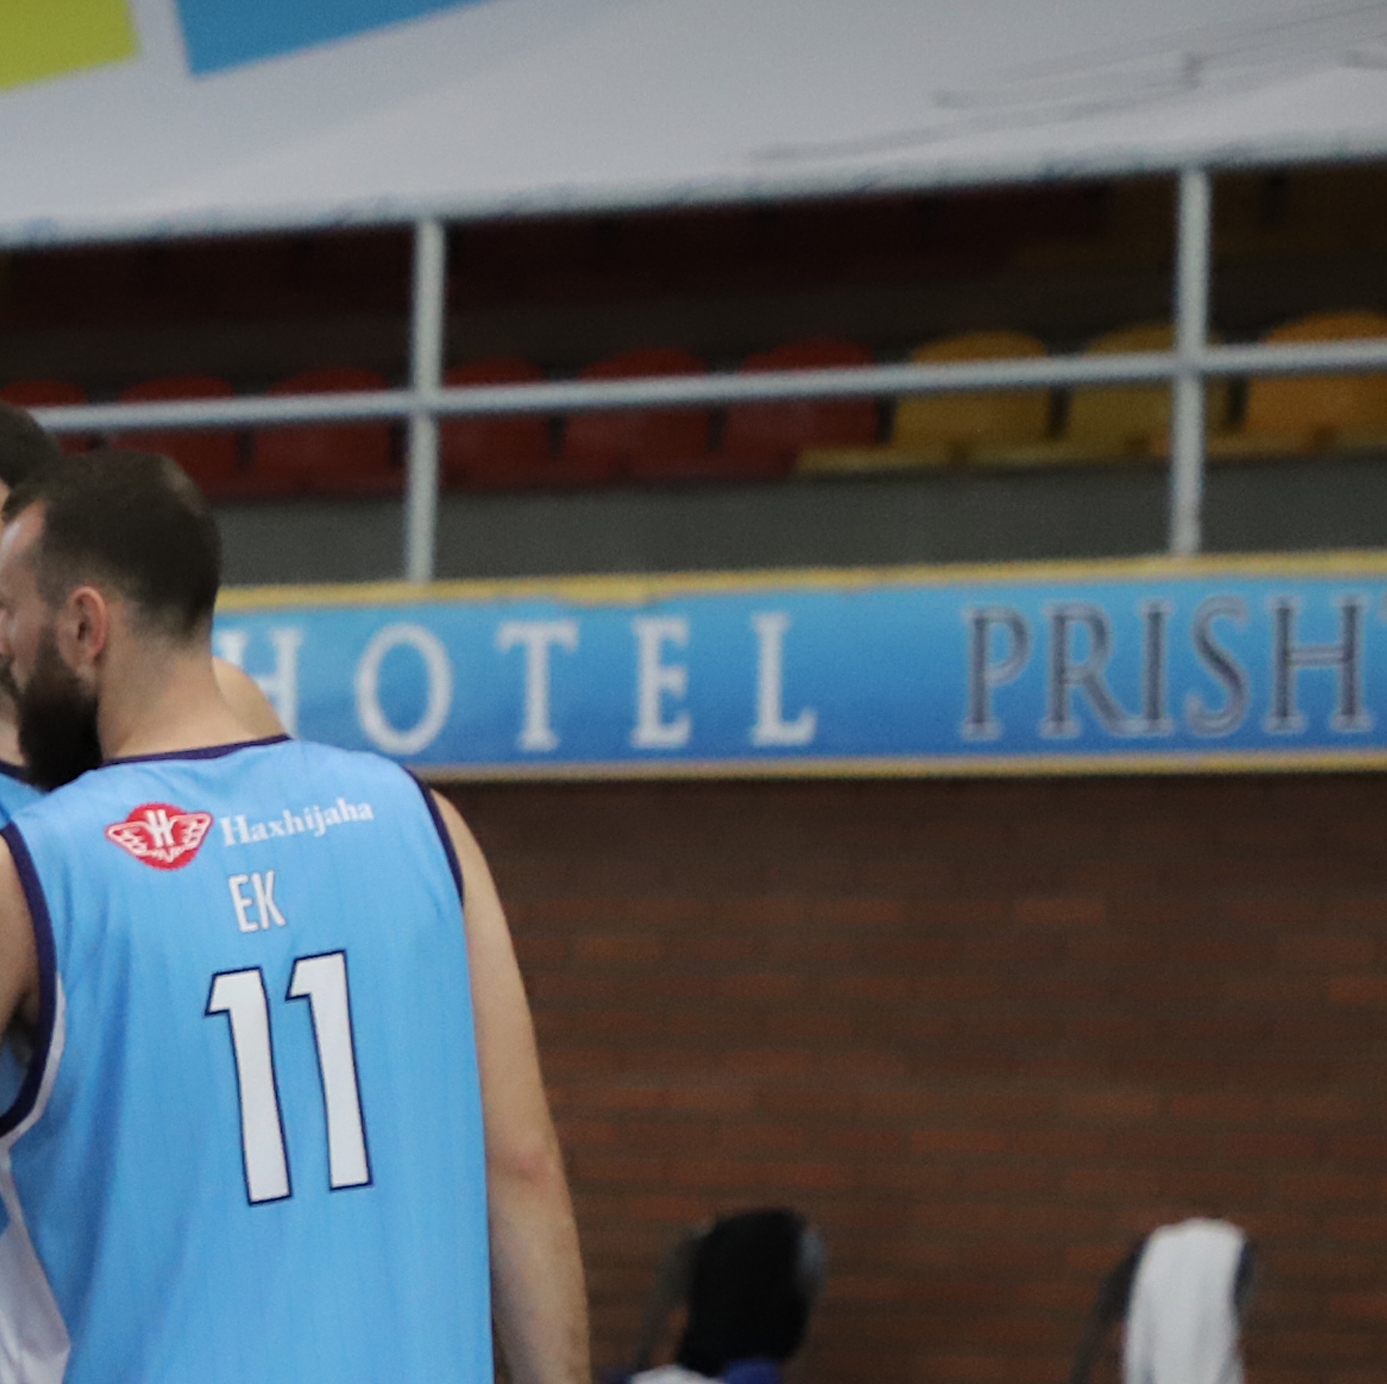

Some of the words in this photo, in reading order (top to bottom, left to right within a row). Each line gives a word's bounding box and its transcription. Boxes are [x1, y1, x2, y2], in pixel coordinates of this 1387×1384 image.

[217, 612, 817, 755] HOTEL
[960, 596, 1385, 741] PRISH
[218, 797, 375, 848] Haxhijaha
[228, 869, 287, 934] EK
[204, 950, 374, 1207] 11
